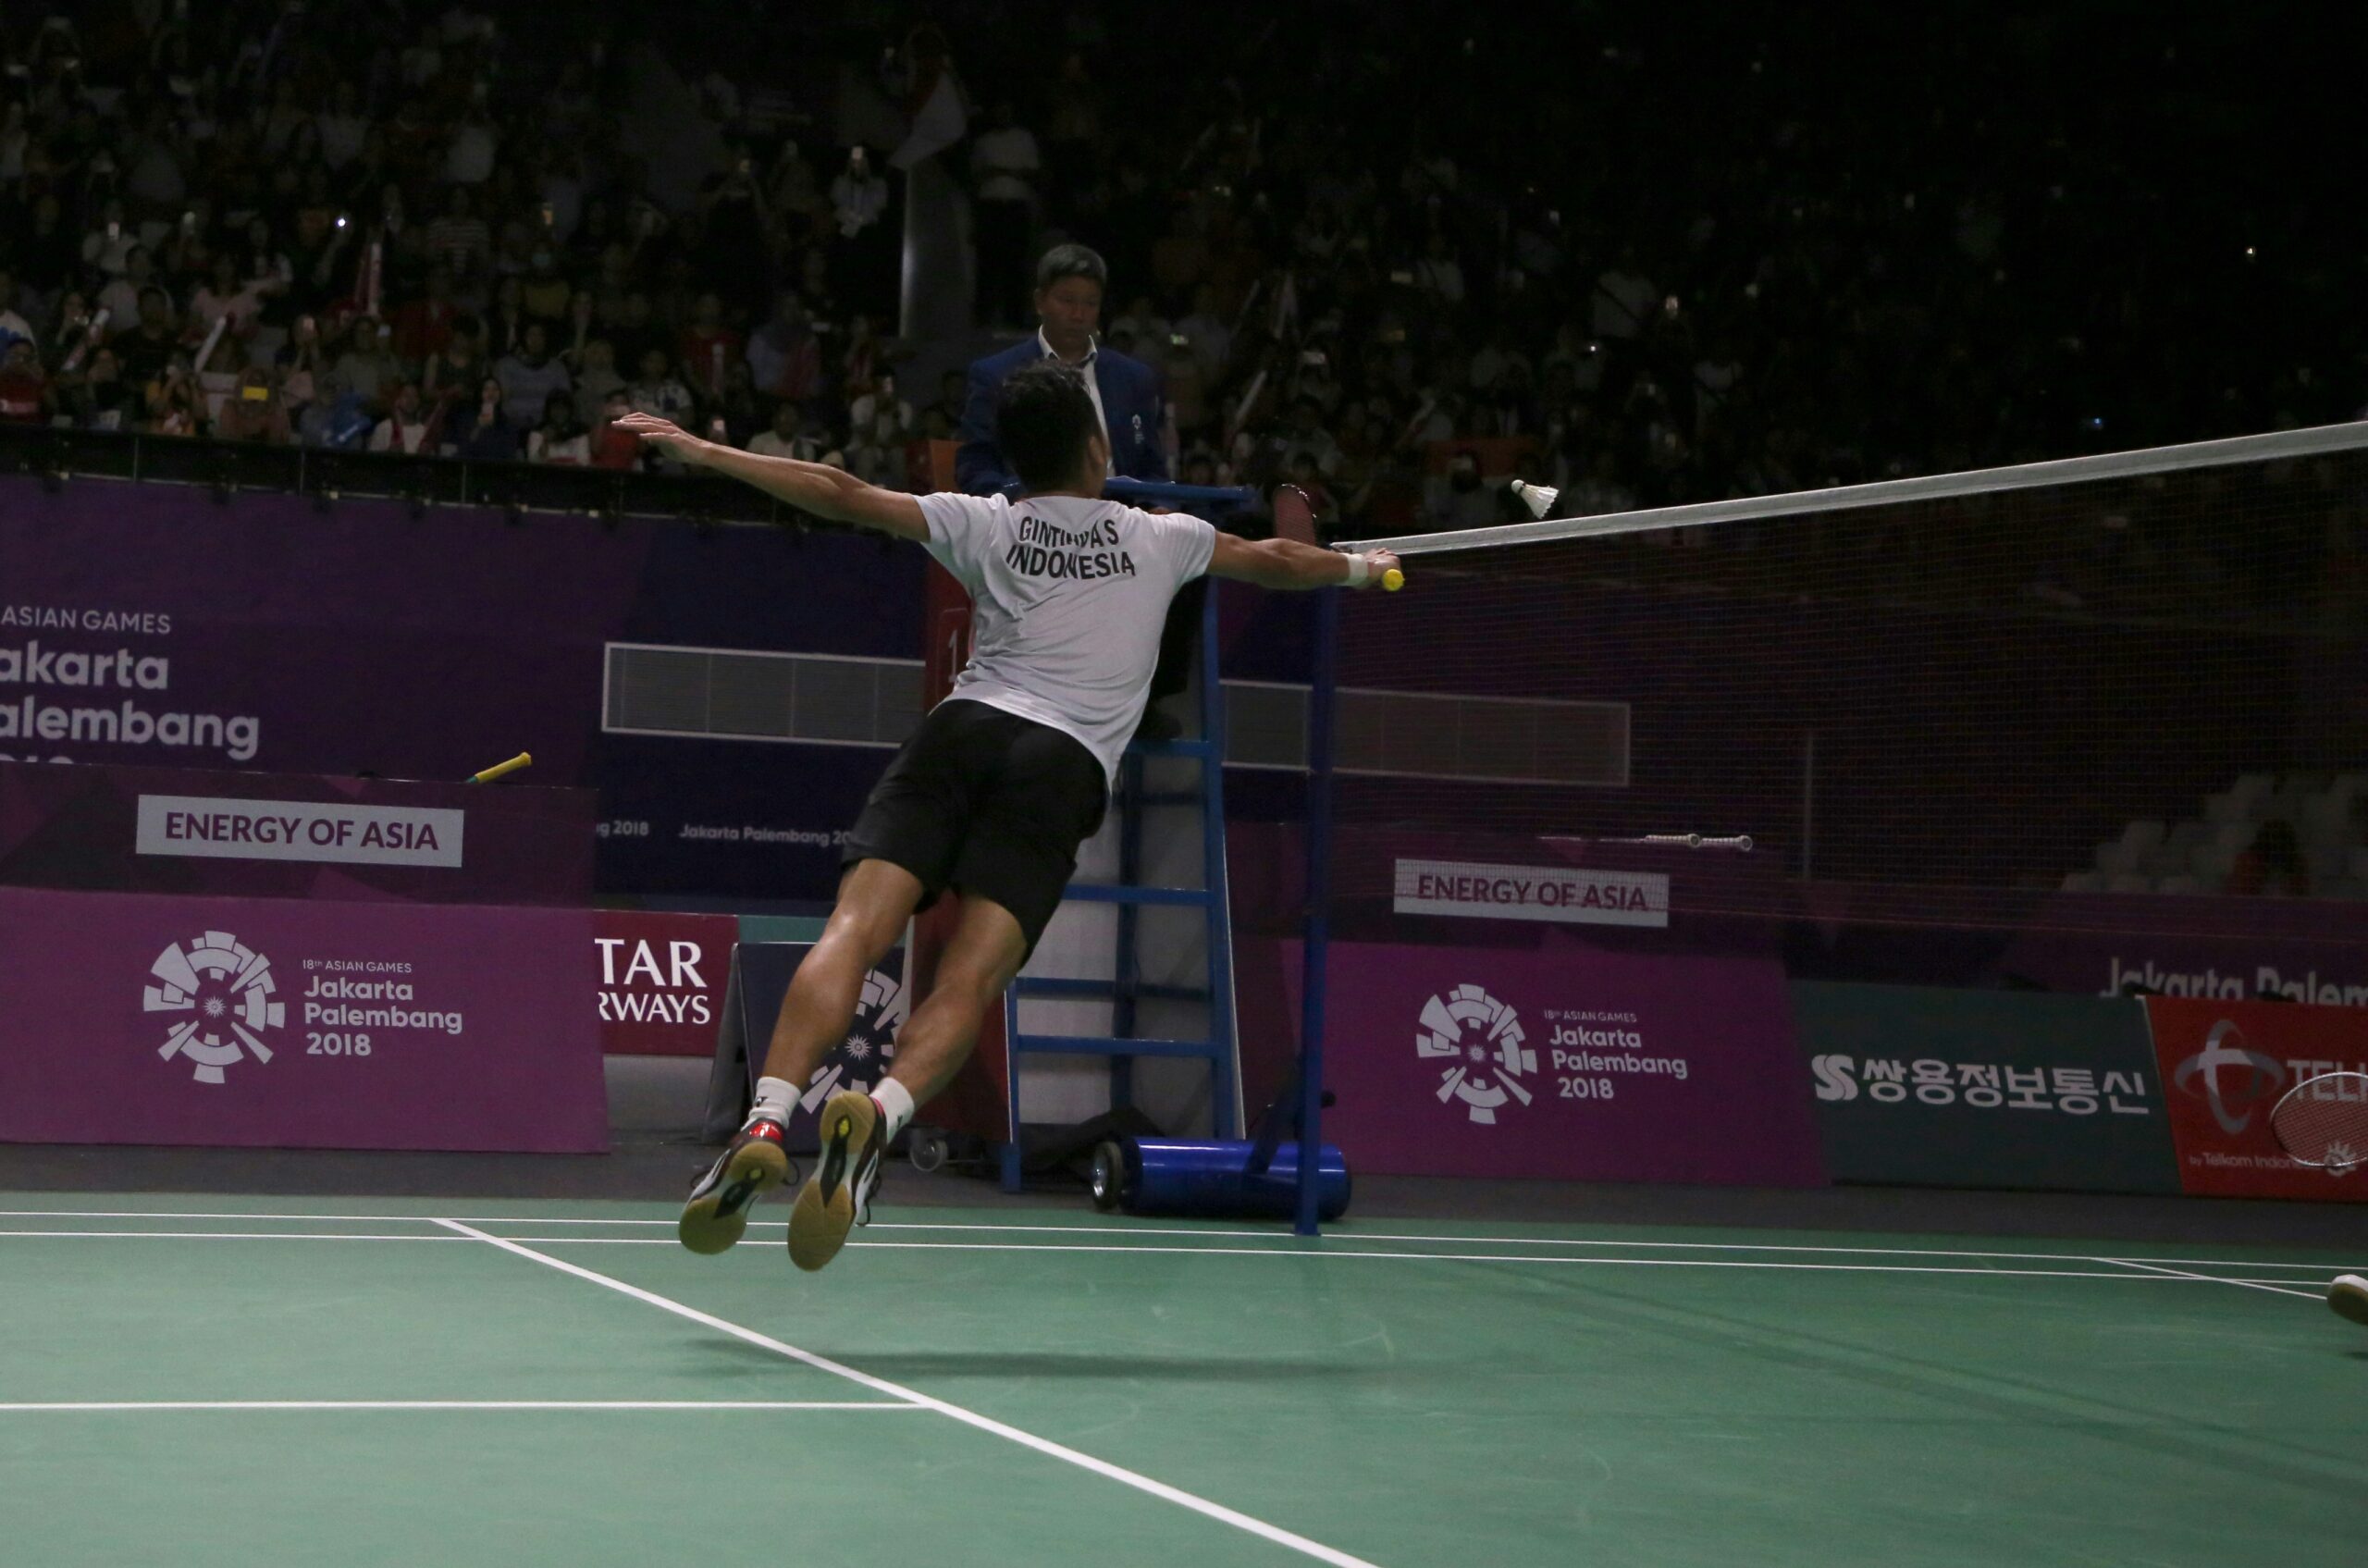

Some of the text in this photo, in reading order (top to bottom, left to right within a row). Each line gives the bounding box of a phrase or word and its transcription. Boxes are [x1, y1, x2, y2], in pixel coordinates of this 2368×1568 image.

[1005, 544, 1136, 579] INDONESIA
[1, 605, 171, 635] ASIAN GAMES
[0, 639, 168, 690] akarta
[0, 695, 259, 761] alembang
[166, 811, 438, 850] ENERGY OF ASIA
[613, 820, 649, 836] 2018
[679, 822, 739, 840] Jakarta
[743, 826, 829, 847] Palembang
[1417, 874, 1648, 911] ENERGY OF ASIA
[325, 959, 364, 971] ASIAN
[366, 961, 412, 973] GAMES
[594, 937, 708, 988] TAR
[303, 975, 413, 1001] Jakarta
[304, 1002, 462, 1035] Palembang
[598, 991, 710, 1025] RWAYS
[1563, 1010, 1597, 1021] ASIAN
[1598, 1011, 1637, 1023] GAMES
[306, 1031, 372, 1056] 2018
[1549, 1024, 1642, 1048] Jakarta
[1551, 1049, 1688, 1080] Palembang
[1558, 1077, 1614, 1099] 2018
[1863, 1059, 2150, 1115] 쌍용정보통신
[2202, 1152, 2252, 1167] Telkom
